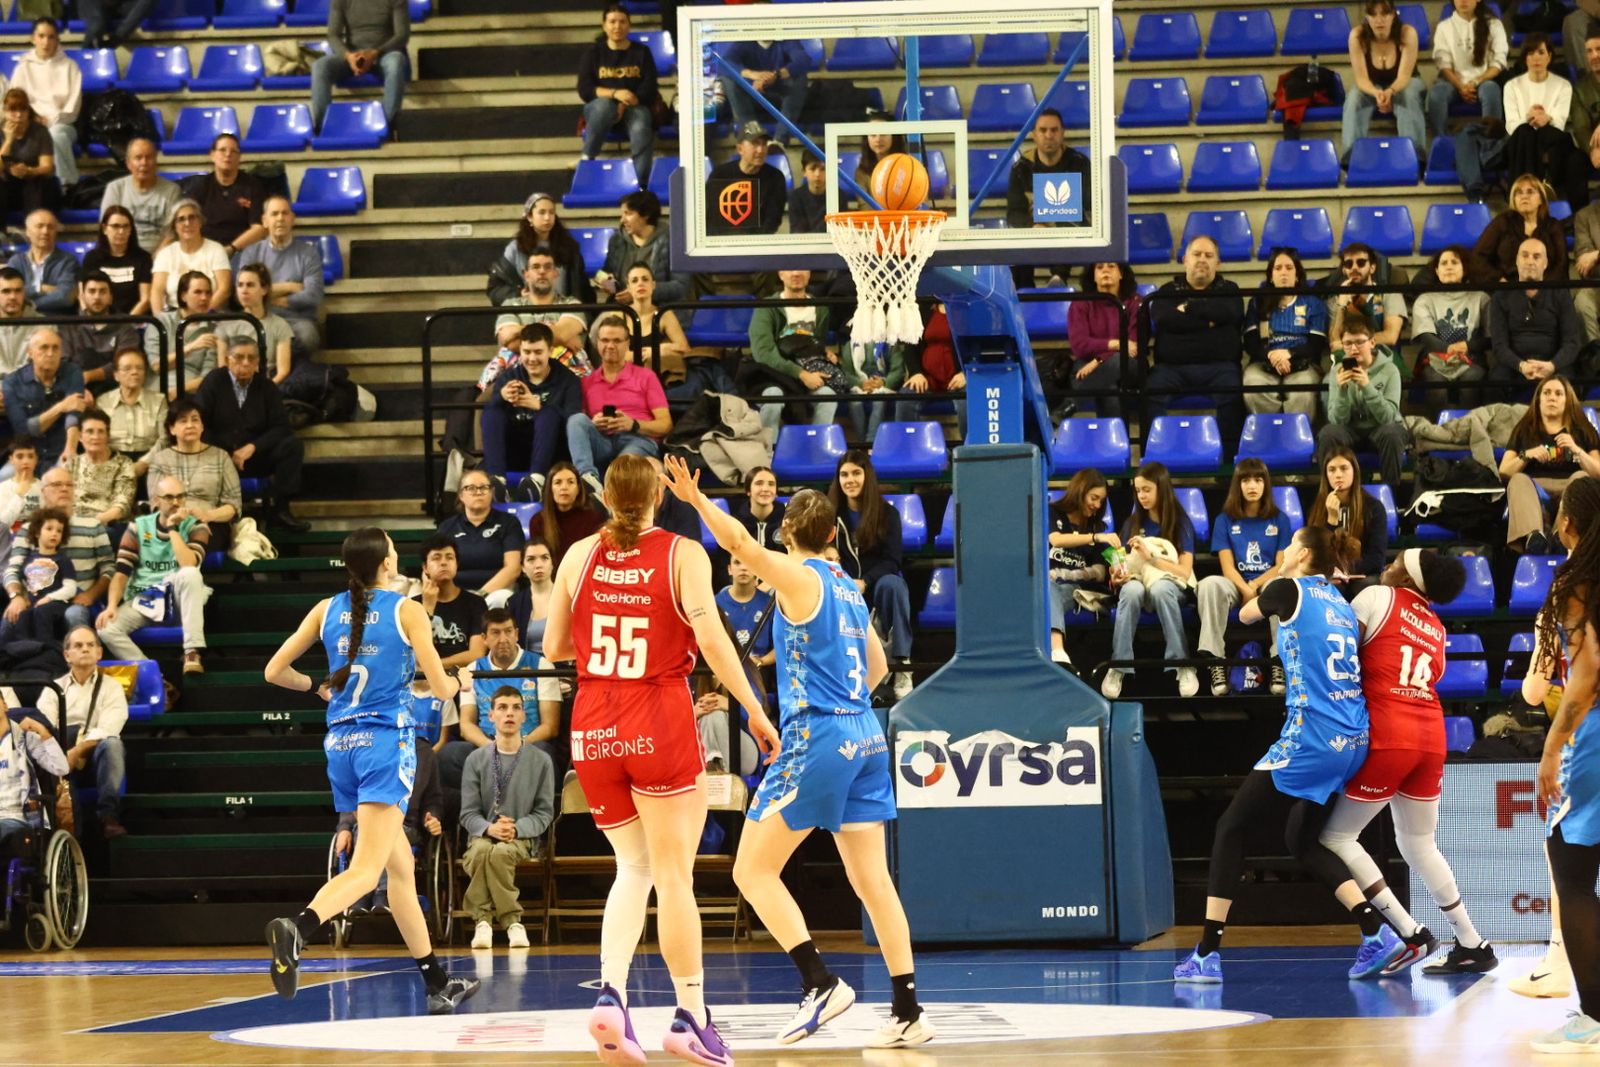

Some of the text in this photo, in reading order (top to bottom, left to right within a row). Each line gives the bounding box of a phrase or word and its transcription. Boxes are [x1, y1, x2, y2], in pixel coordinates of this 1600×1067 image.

[986, 387, 1000, 444] MONDO
[592, 565, 656, 585] BIBBY
[618, 592, 652, 605] Home
[586, 613, 649, 679] 55
[1326, 632, 1362, 683] 23
[846, 646, 863, 700] 3
[1399, 644, 1433, 692] 14
[350, 664, 369, 708] 7
[262, 712, 291, 720] FILA 2
[585, 725, 617, 742] espai
[585, 735, 655, 761] GIRONÈS
[225, 796, 254, 805] FILA 1
[1041, 904, 1100, 919] MONDO
